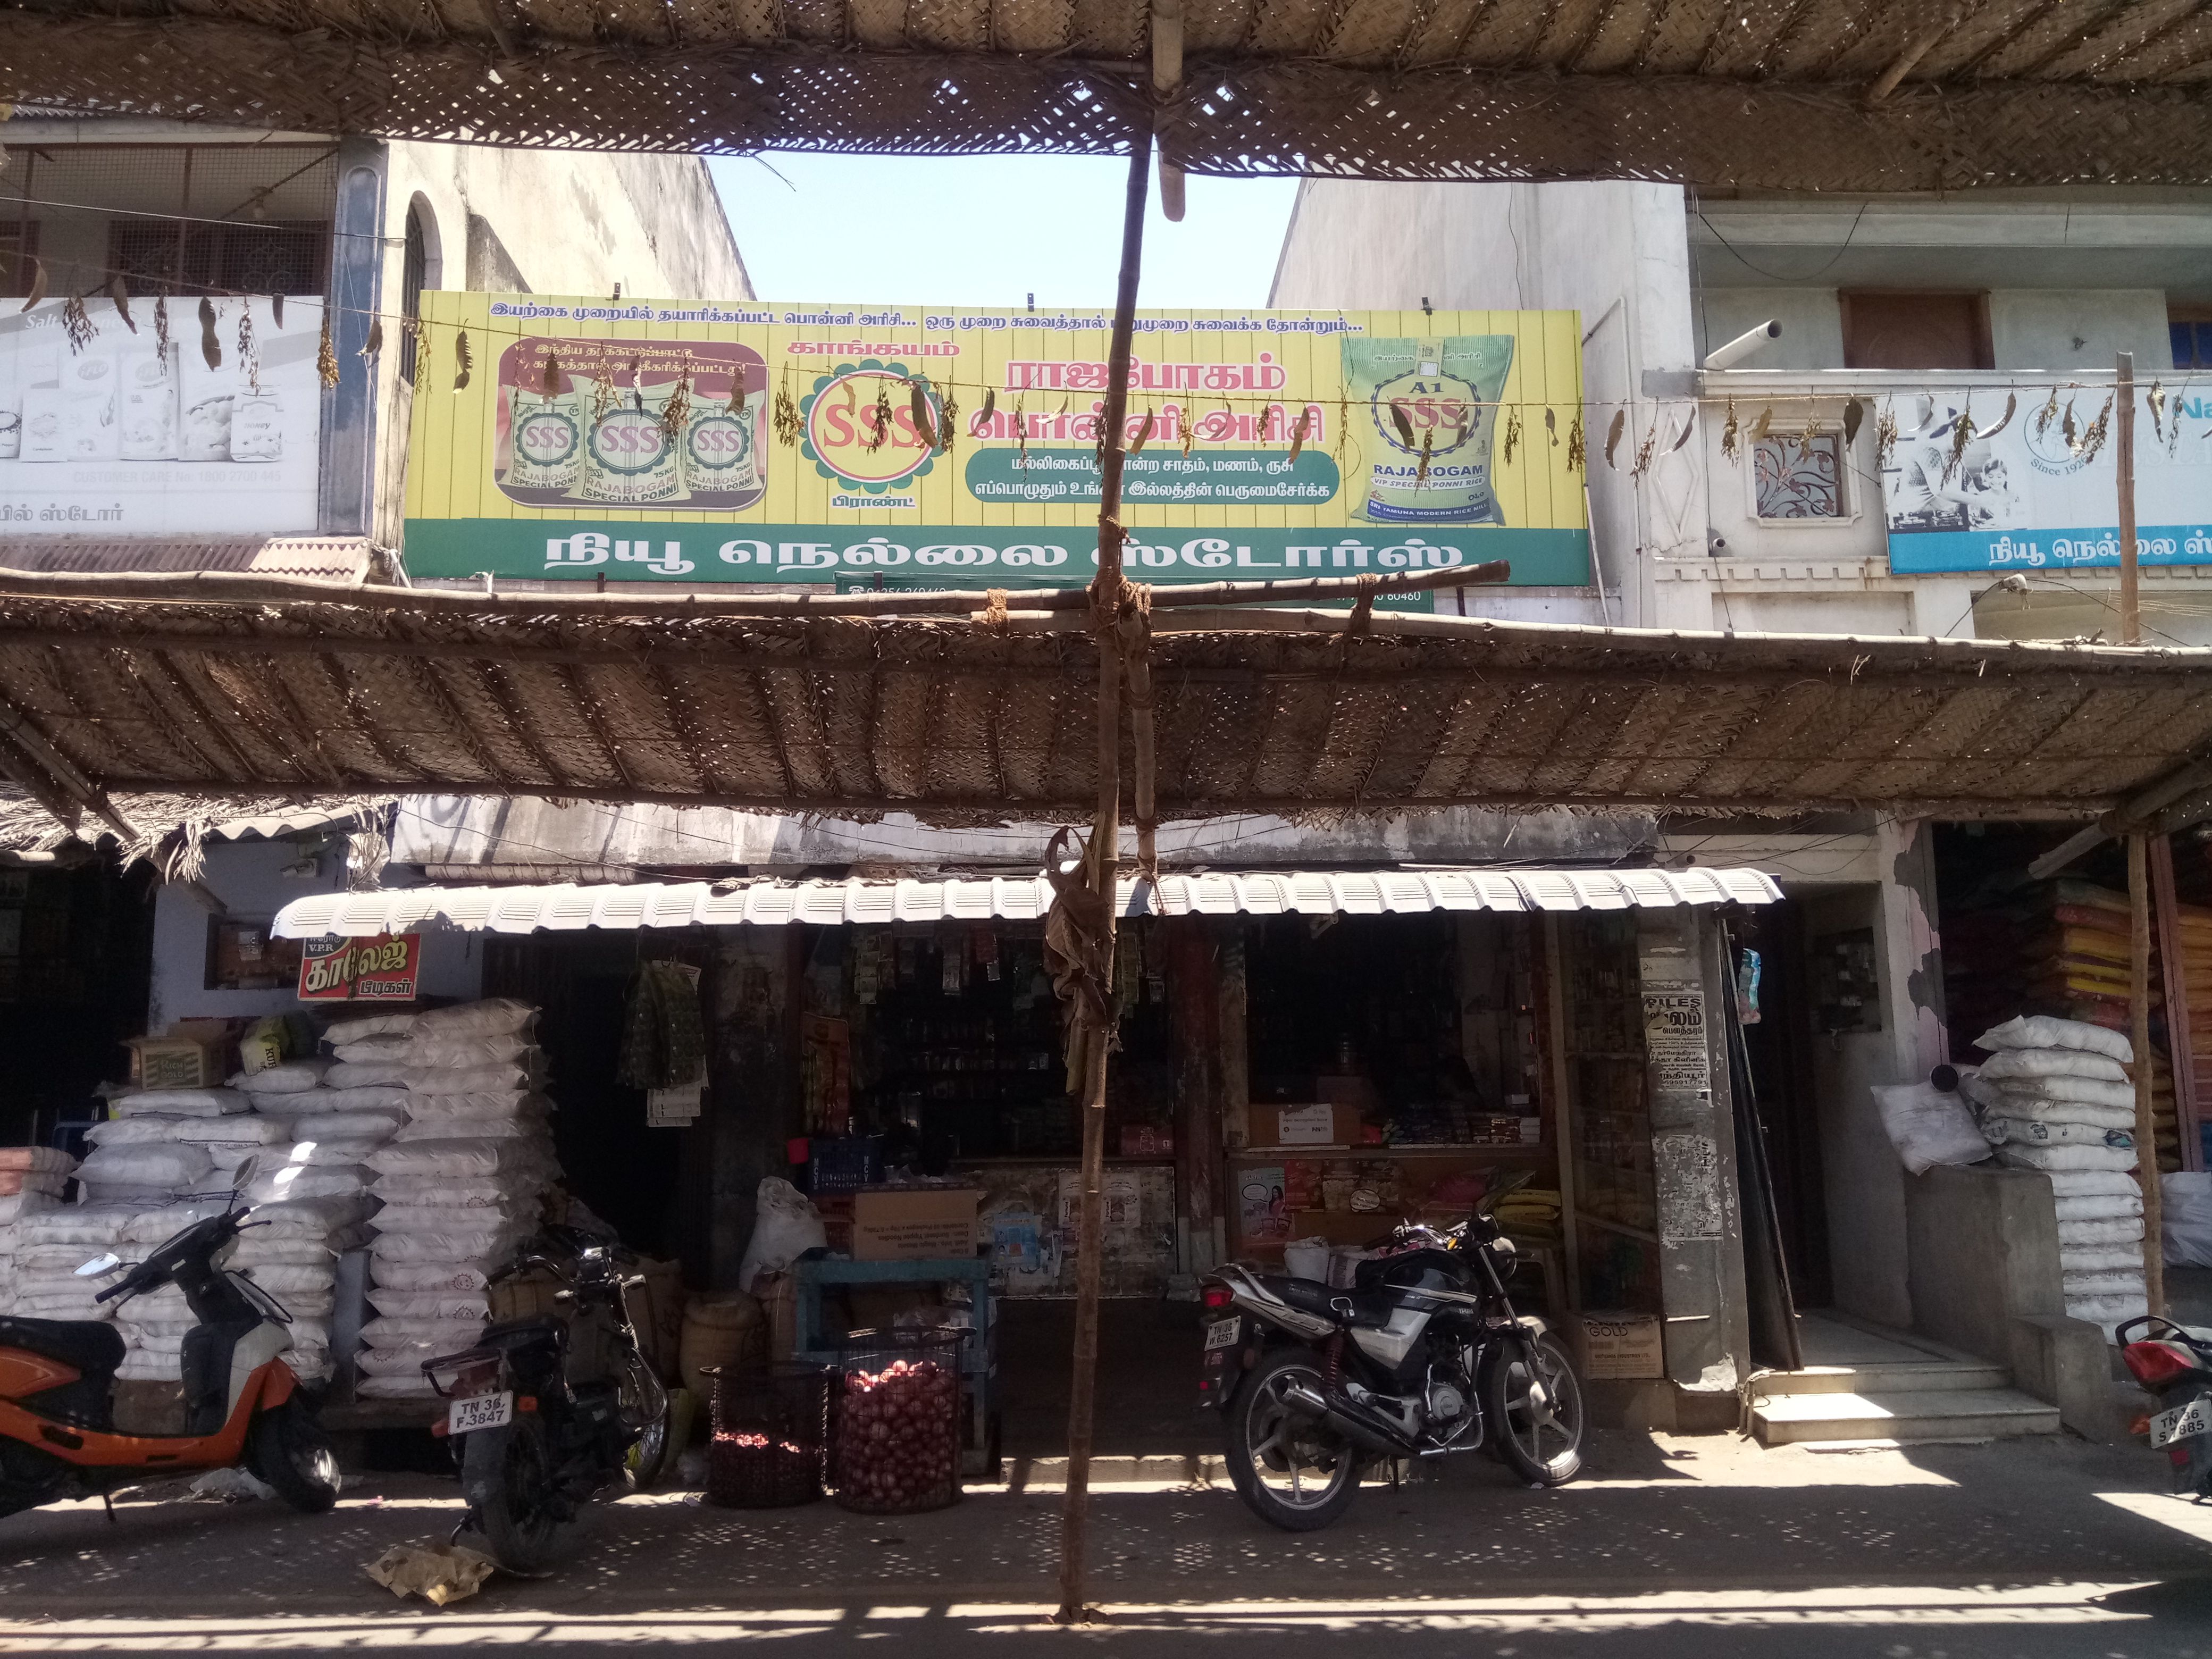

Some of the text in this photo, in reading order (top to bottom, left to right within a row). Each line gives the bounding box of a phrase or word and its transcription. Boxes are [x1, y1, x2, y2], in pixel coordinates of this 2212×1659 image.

[491, 302, 567, 320] இயற்கை
[574, 306, 654, 321] முறையில்
[658, 307, 780, 323] தயாரிக்கப்பட்ட
[785, 311, 853, 325] பொன்னி
[926, 315, 955, 330] ஒரு
[960, 316, 1006, 330] முறை
[1011, 315, 1106, 331] சுவைத்தால்
[1194, 317, 1262, 332] சுவைக்க
[787, 339, 960, 356] காங்கயம்
[1409, 382, 1444, 394] A1
[526, 425, 568, 449] SSS
[601, 425, 659, 454] SSS
[697, 430, 740, 452] SSS
[653, 466, 674, 479] 75KG
[1213, 457, 1263, 474] மணம்,
[2030, 457, 2061, 476] Since
[73, 471, 137, 484] CUSTOMER
[141, 471, 172, 484] CARE
[198, 471, 227, 483] 1800
[513, 476, 554, 488] SPECIAL
[586, 474, 675, 495] RAJABOGAM
[686, 469, 751, 485] RAJABOGAM
[686, 476, 752, 492] SPECIAL PONNI
[585, 482, 676, 502] SPECIAL PONNI
[975, 480, 1067, 499] எப்பொழுதும்
[1128, 481, 1212, 500] இல்லத்தின்
[832, 496, 916, 508] பிராண்ட்
[1370, 501, 1381, 509] SRI
[544, 532, 696, 575] நியூ
[718, 537, 1068, 574] நெல்லை
[1989, 536, 2046, 566] நியூ
[308, 943, 334, 952] V.P.R
[1214, 1325, 1222, 1335] TN
[462, 1402, 479, 1414] TN
[2160, 1409, 2199, 1428] TN 36
